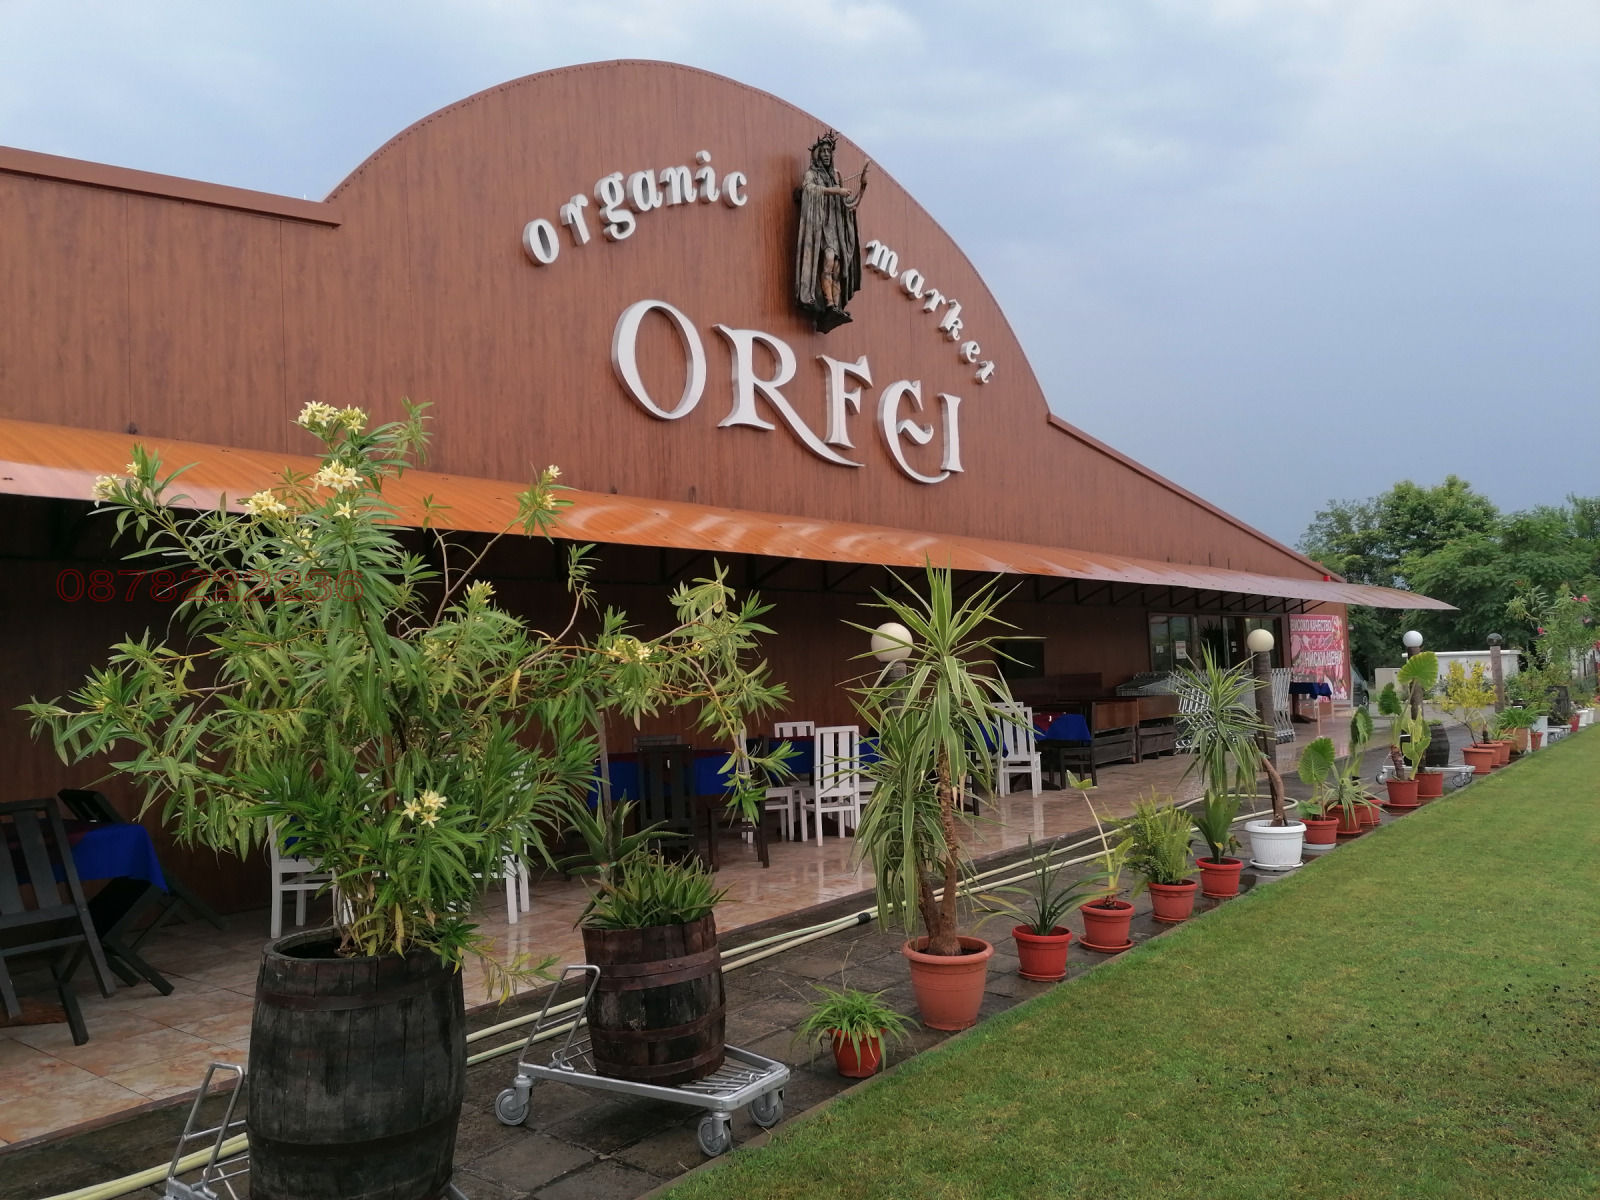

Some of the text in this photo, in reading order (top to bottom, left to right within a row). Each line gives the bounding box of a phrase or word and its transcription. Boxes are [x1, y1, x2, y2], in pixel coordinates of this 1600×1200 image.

[522, 150, 996, 385] organic market
[611, 299, 965, 484] ORFEI
[1291, 619, 1332, 632] ВИСОКО КАЧЕСТВО
[1304, 650, 1342, 667] НИСКИ ЦЕНИ
